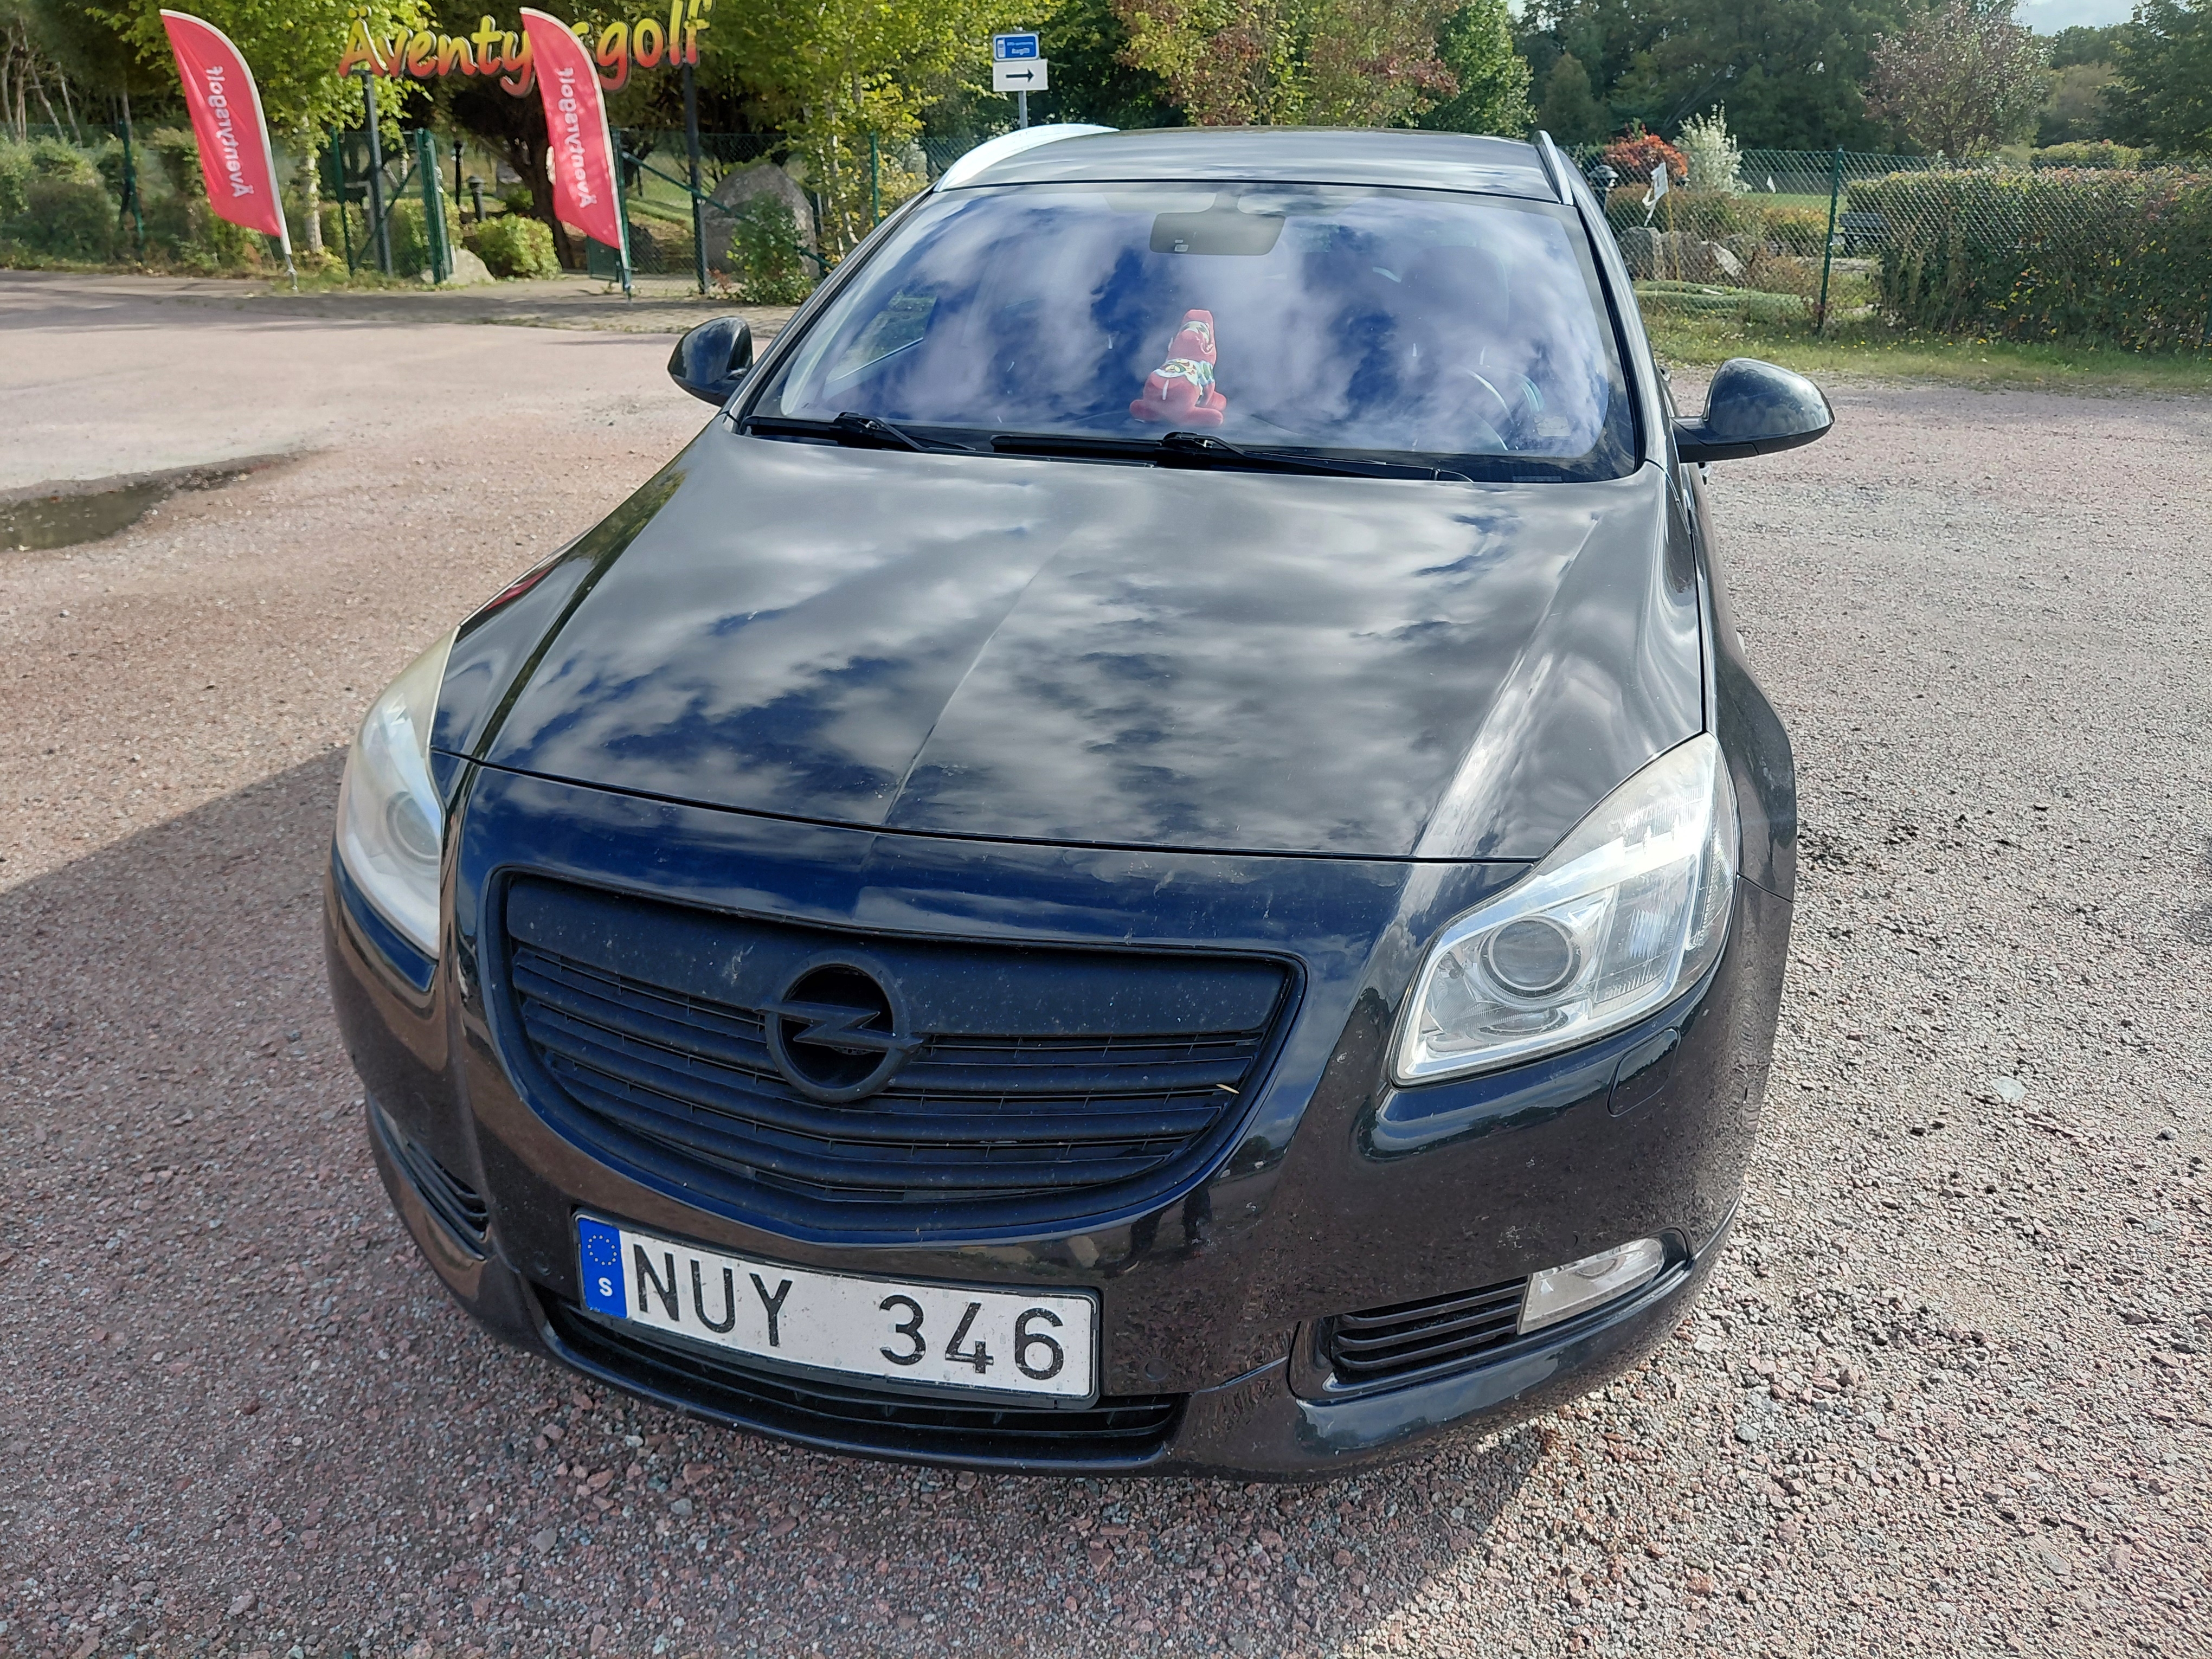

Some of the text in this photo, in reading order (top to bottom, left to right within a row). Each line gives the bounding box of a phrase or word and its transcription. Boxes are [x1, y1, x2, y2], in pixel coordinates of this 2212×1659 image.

[338, 0, 712, 98] Äventygolf
[598, 1277, 613, 1297] S
[633, 1243, 1064, 1380] NUY 346
